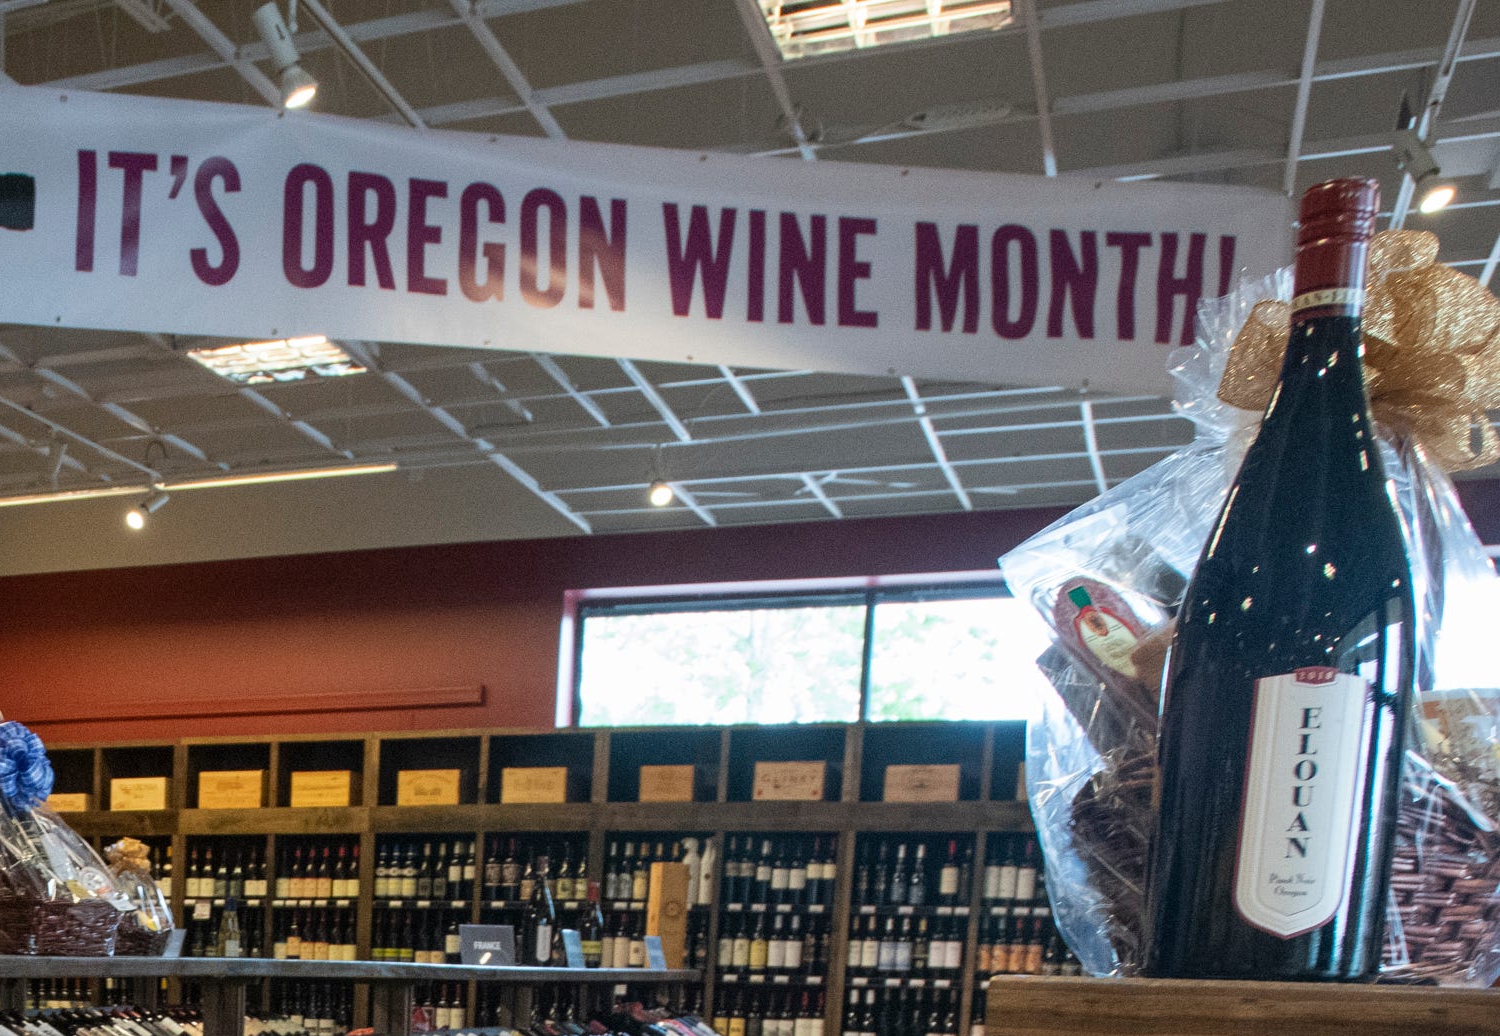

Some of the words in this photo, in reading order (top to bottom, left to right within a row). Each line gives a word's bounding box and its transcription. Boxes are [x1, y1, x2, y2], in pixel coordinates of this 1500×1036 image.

[76, 149, 241, 287] IT'S
[282, 163, 628, 313] OREGON
[662, 202, 879, 328] WINE
[914, 221, 1237, 347] MONTH!
[1283, 706, 1323, 860] ELOUAN
[473, 940, 502, 950] FRANCE
